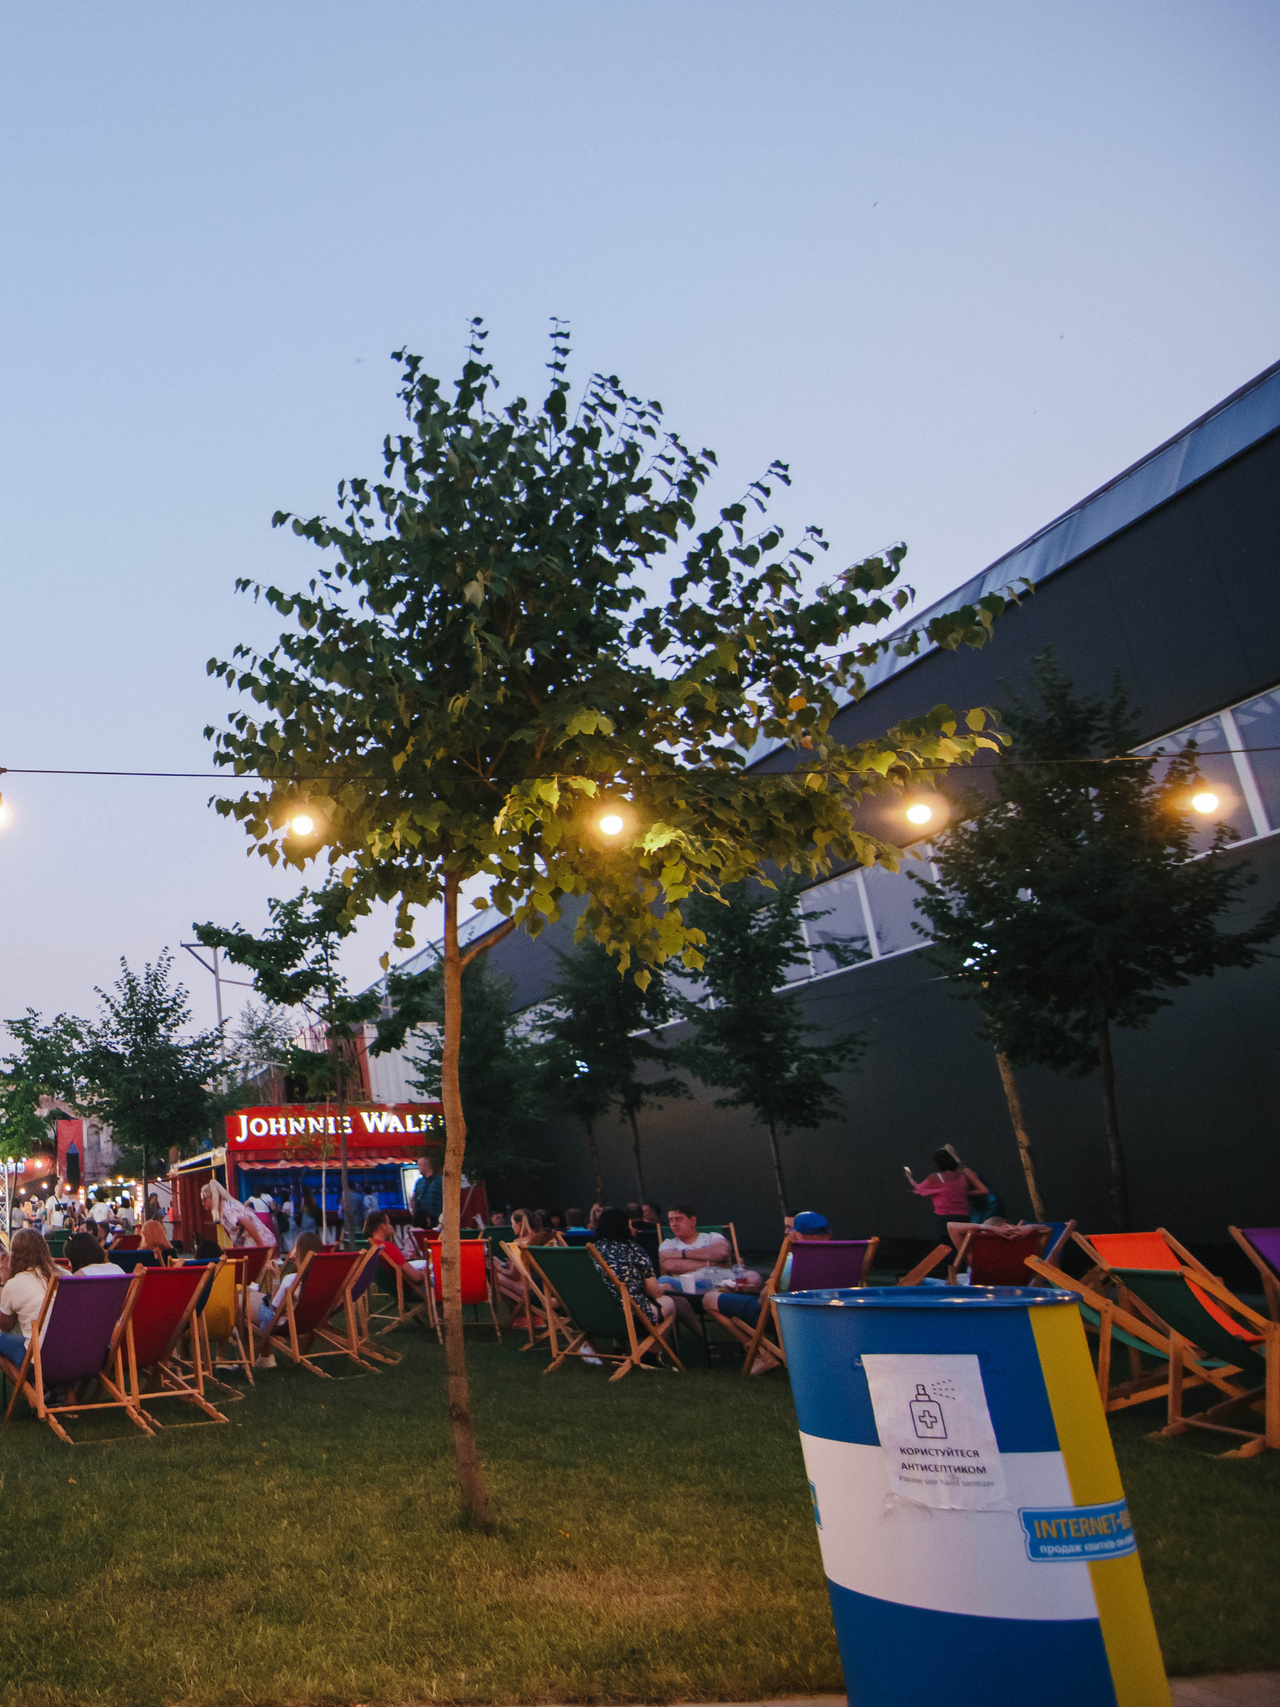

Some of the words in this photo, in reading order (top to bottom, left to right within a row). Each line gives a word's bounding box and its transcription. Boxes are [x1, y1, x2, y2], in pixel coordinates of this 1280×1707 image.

[236, 1115, 353, 1143] JOHNNIE
[360, 1112, 445, 1134] WALK
[899, 1447, 980, 1458] КОРИСТУЙТЕСЯ
[901, 1462, 987, 1474] АНТИСЕПТИКОМ
[898, 1475, 923, 1484] Please
[940, 1478, 960, 1486] hand
[1040, 1544, 1082, 1555] продаж
